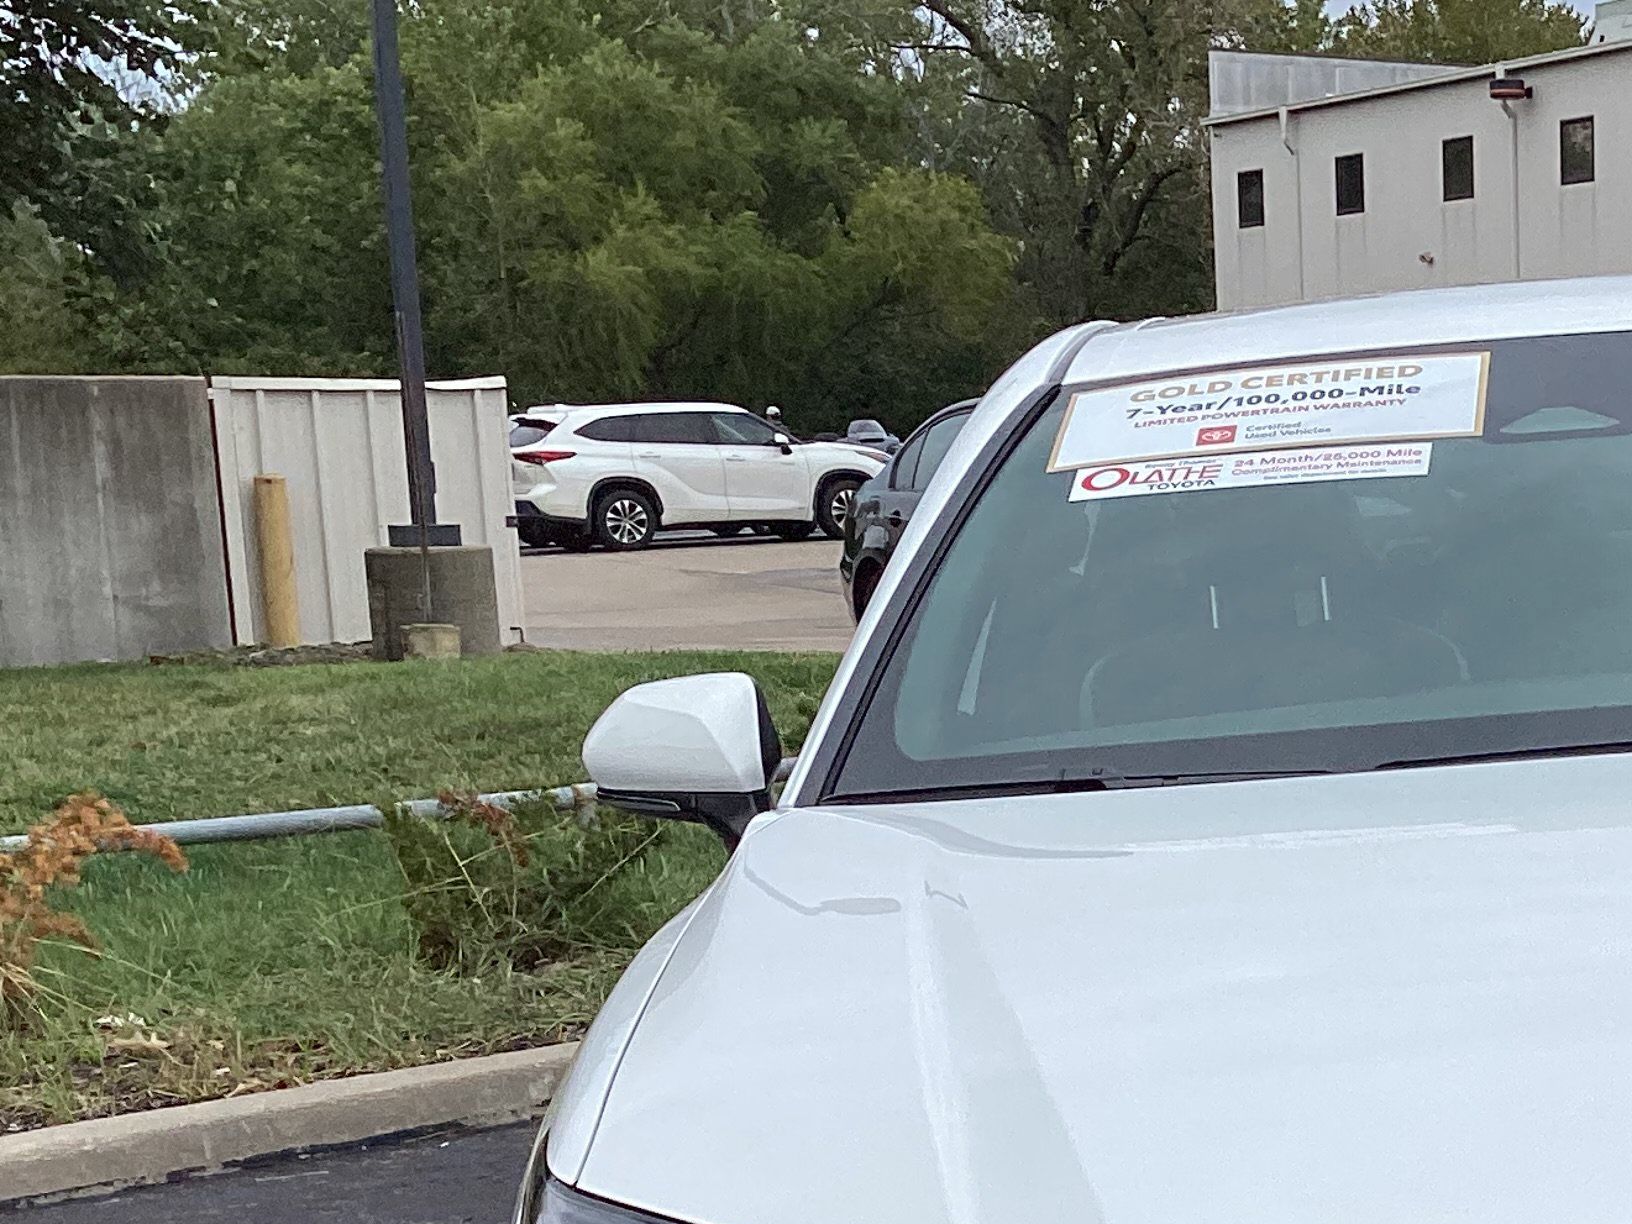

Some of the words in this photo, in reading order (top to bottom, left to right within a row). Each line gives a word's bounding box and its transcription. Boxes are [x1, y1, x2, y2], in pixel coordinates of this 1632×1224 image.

[1130, 381, 1232, 403] GOLD
[1240, 365, 1423, 389] CERTIFIED
[1126, 384, 1421, 419] 7-Year/100,000-Mile
[1134, 415, 1198, 428] LIMITED
[1201, 405, 1309, 421] POWERTRAIN
[1313, 399, 1407, 411] WARRANTY
[1246, 421, 1301, 432] Certified
[1280, 426, 1331, 436] Vehicles
[1386, 448, 1422, 458] Mile
[1149, 479, 1215, 491] TOYOTA
